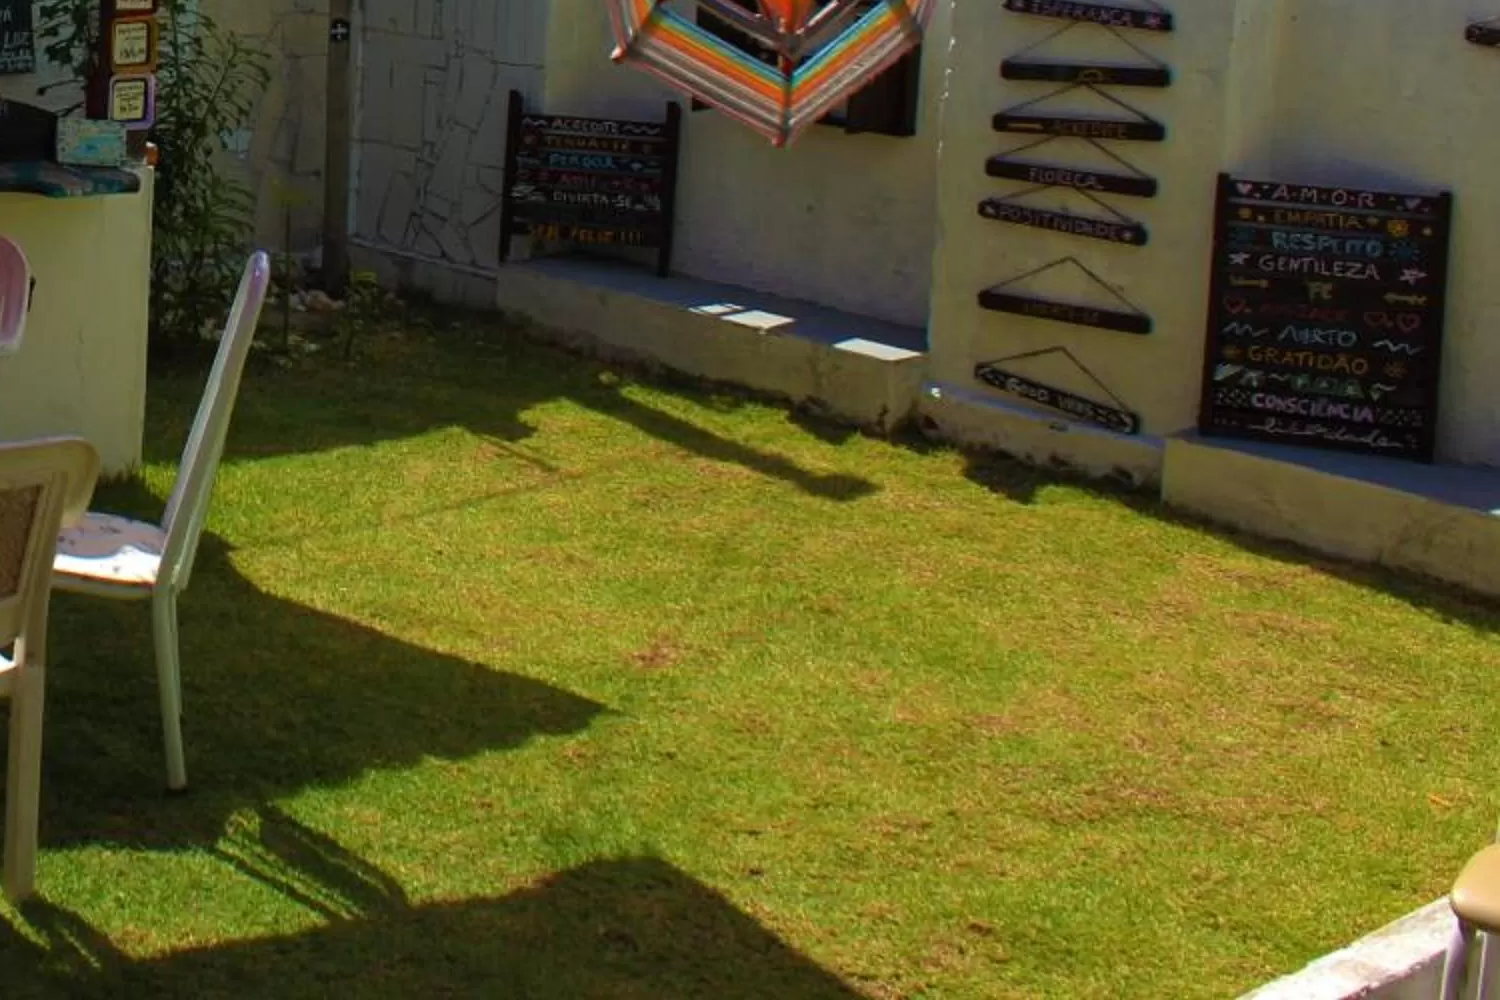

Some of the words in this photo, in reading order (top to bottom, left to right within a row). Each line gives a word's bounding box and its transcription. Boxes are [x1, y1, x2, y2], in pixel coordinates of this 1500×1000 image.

[1271, 230, 1385, 258] RESPEITO
[1259, 254, 1380, 280] GENTILEZA
[1247, 347, 1369, 377] GRATIDÃO
